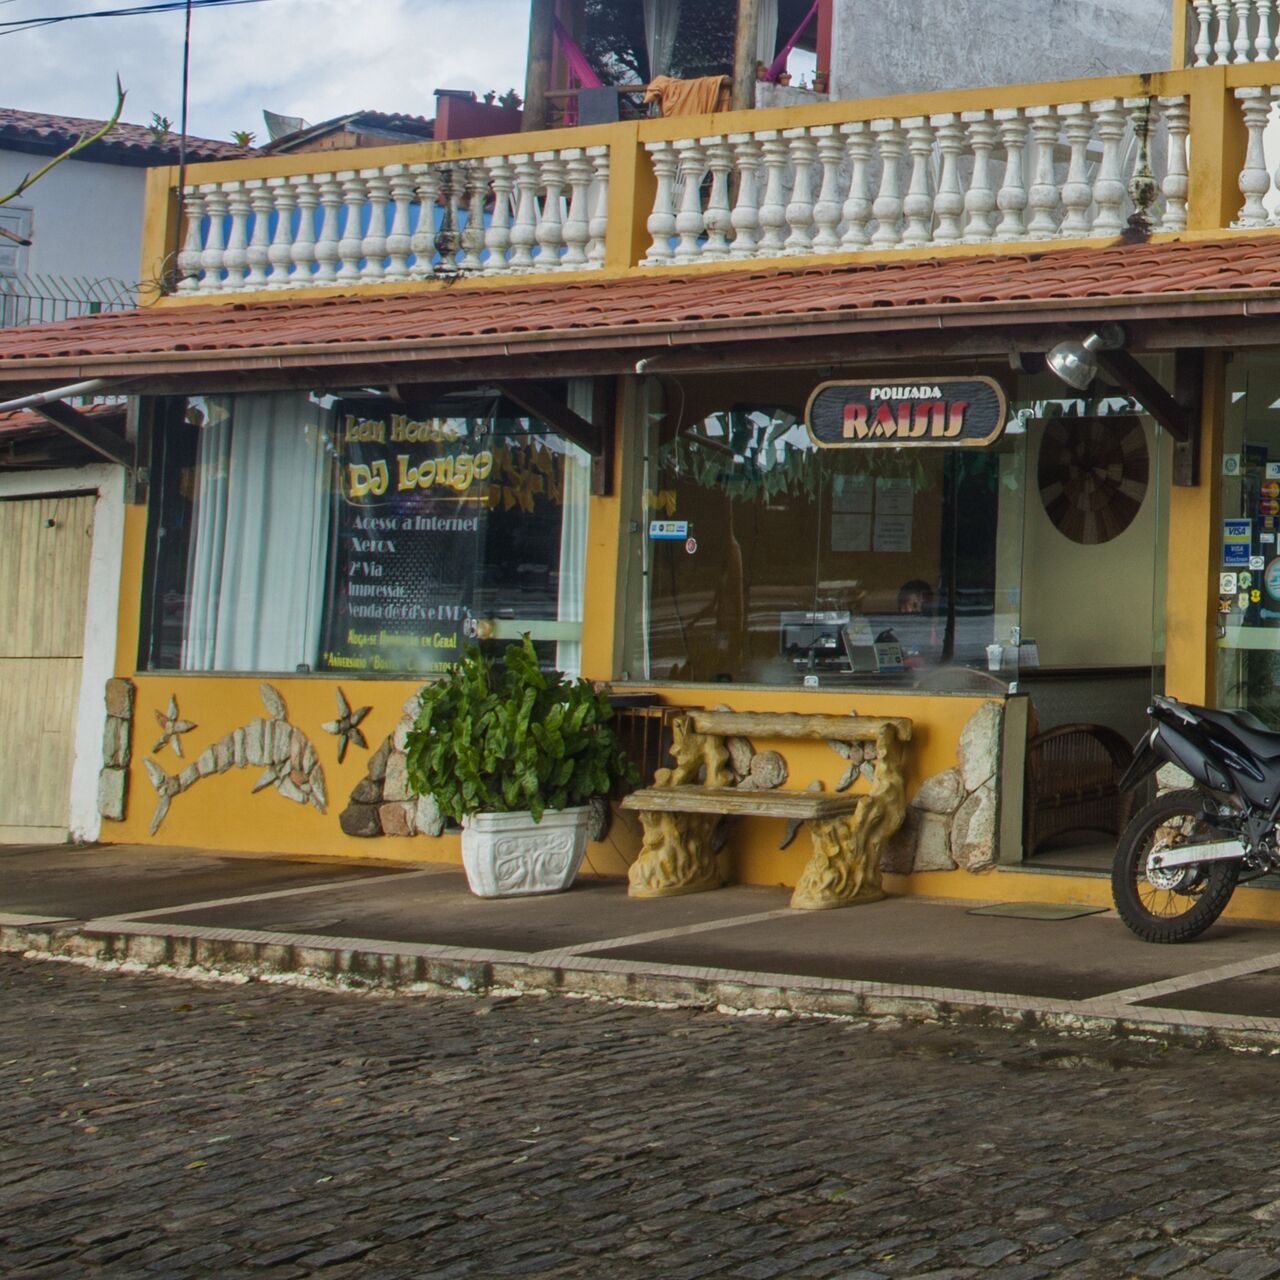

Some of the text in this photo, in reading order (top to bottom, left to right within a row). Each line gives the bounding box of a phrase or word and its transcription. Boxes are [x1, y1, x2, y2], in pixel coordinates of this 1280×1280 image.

[870, 386, 942, 400] POUSADA
[842, 401, 968, 439] RAISIS
[345, 414, 386, 444] Lan
[349, 451, 493, 497] DJ Longo
[352, 515, 398, 530] Acesso
[415, 516, 478, 532] Internet
[1228, 527, 1246, 536] VISA
[351, 537, 396, 553] Xerox
[363, 561, 383, 577] Via
[348, 603, 383, 619] Venda
[384, 604, 399, 619] de
